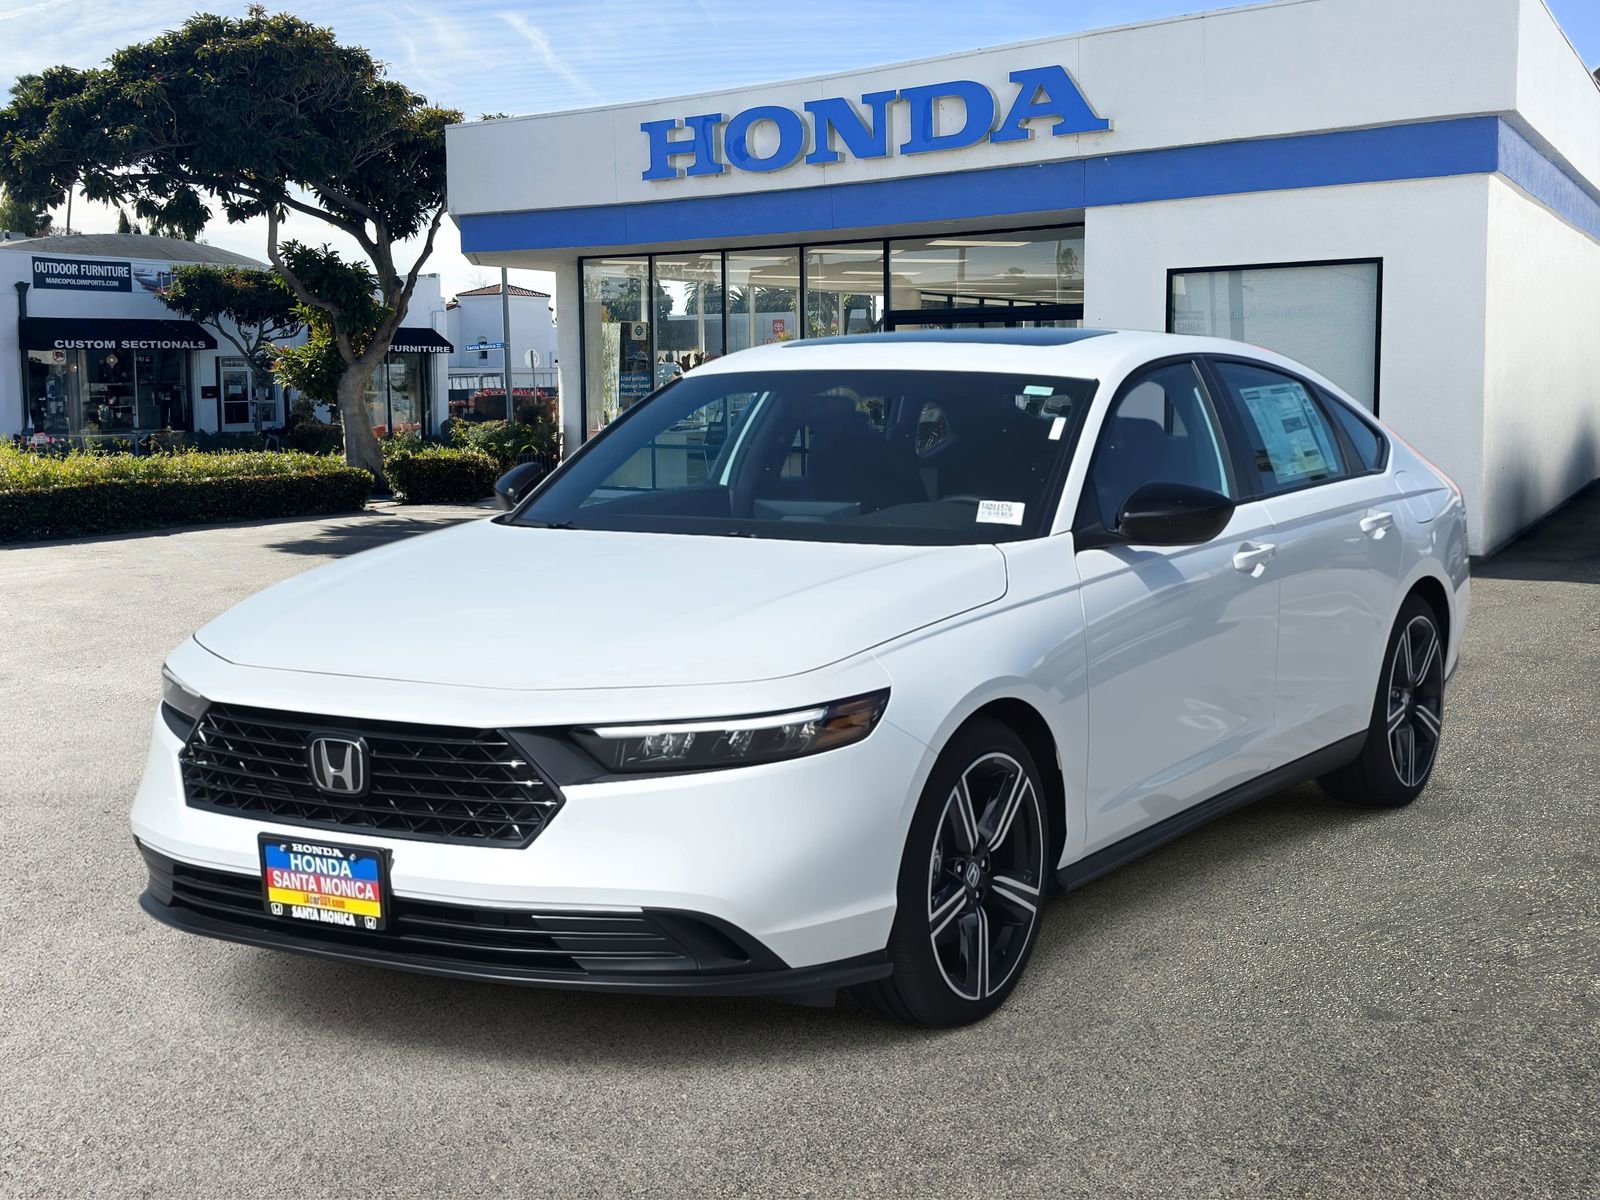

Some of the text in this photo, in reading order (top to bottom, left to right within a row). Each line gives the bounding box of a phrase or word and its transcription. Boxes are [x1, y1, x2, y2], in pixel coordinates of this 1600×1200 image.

[640, 65, 1110, 181] HONDA
[34, 261, 129, 277] OUTDOOR FURNITURE
[45, 277, 119, 286] MARCOPOLOIMPORTS.COM
[54, 339, 206, 349] CUSTOM SECTIONALS
[291, 843, 344, 858] HONDA
[289, 853, 353, 878] HONDA
[272, 870, 376, 900] SANTA MONICA
[291, 905, 356, 927] SANTA MONICA
